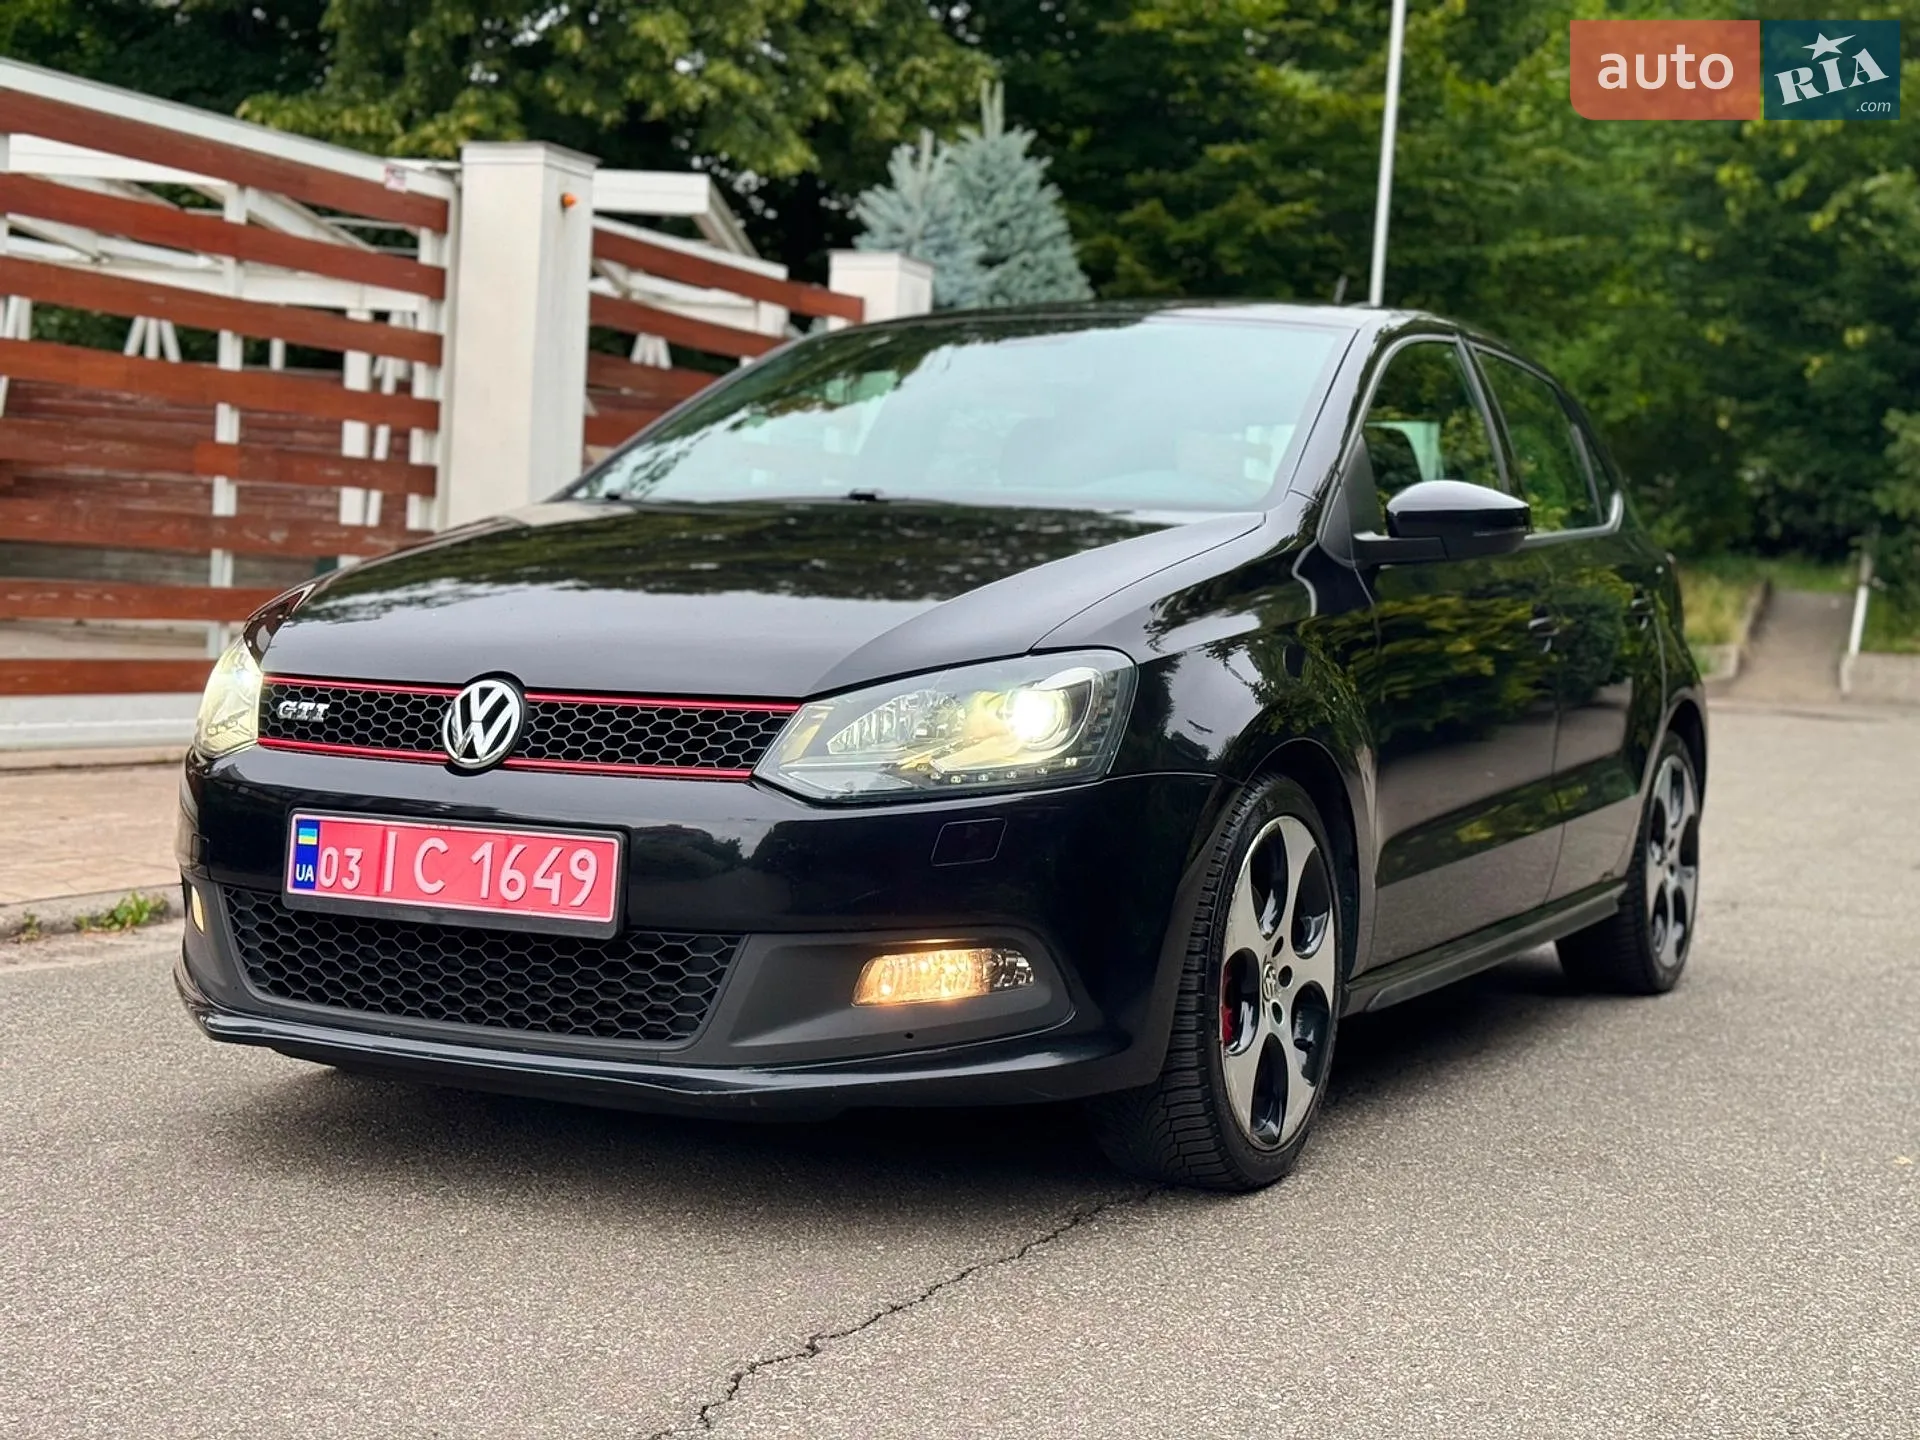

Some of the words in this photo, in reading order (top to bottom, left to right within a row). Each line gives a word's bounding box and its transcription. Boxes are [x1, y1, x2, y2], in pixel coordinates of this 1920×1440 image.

[277, 701, 329, 722] GTI
[295, 863, 315, 883] UA
[319, 847, 363, 890] 03
[470, 841, 598, 907] 1649
